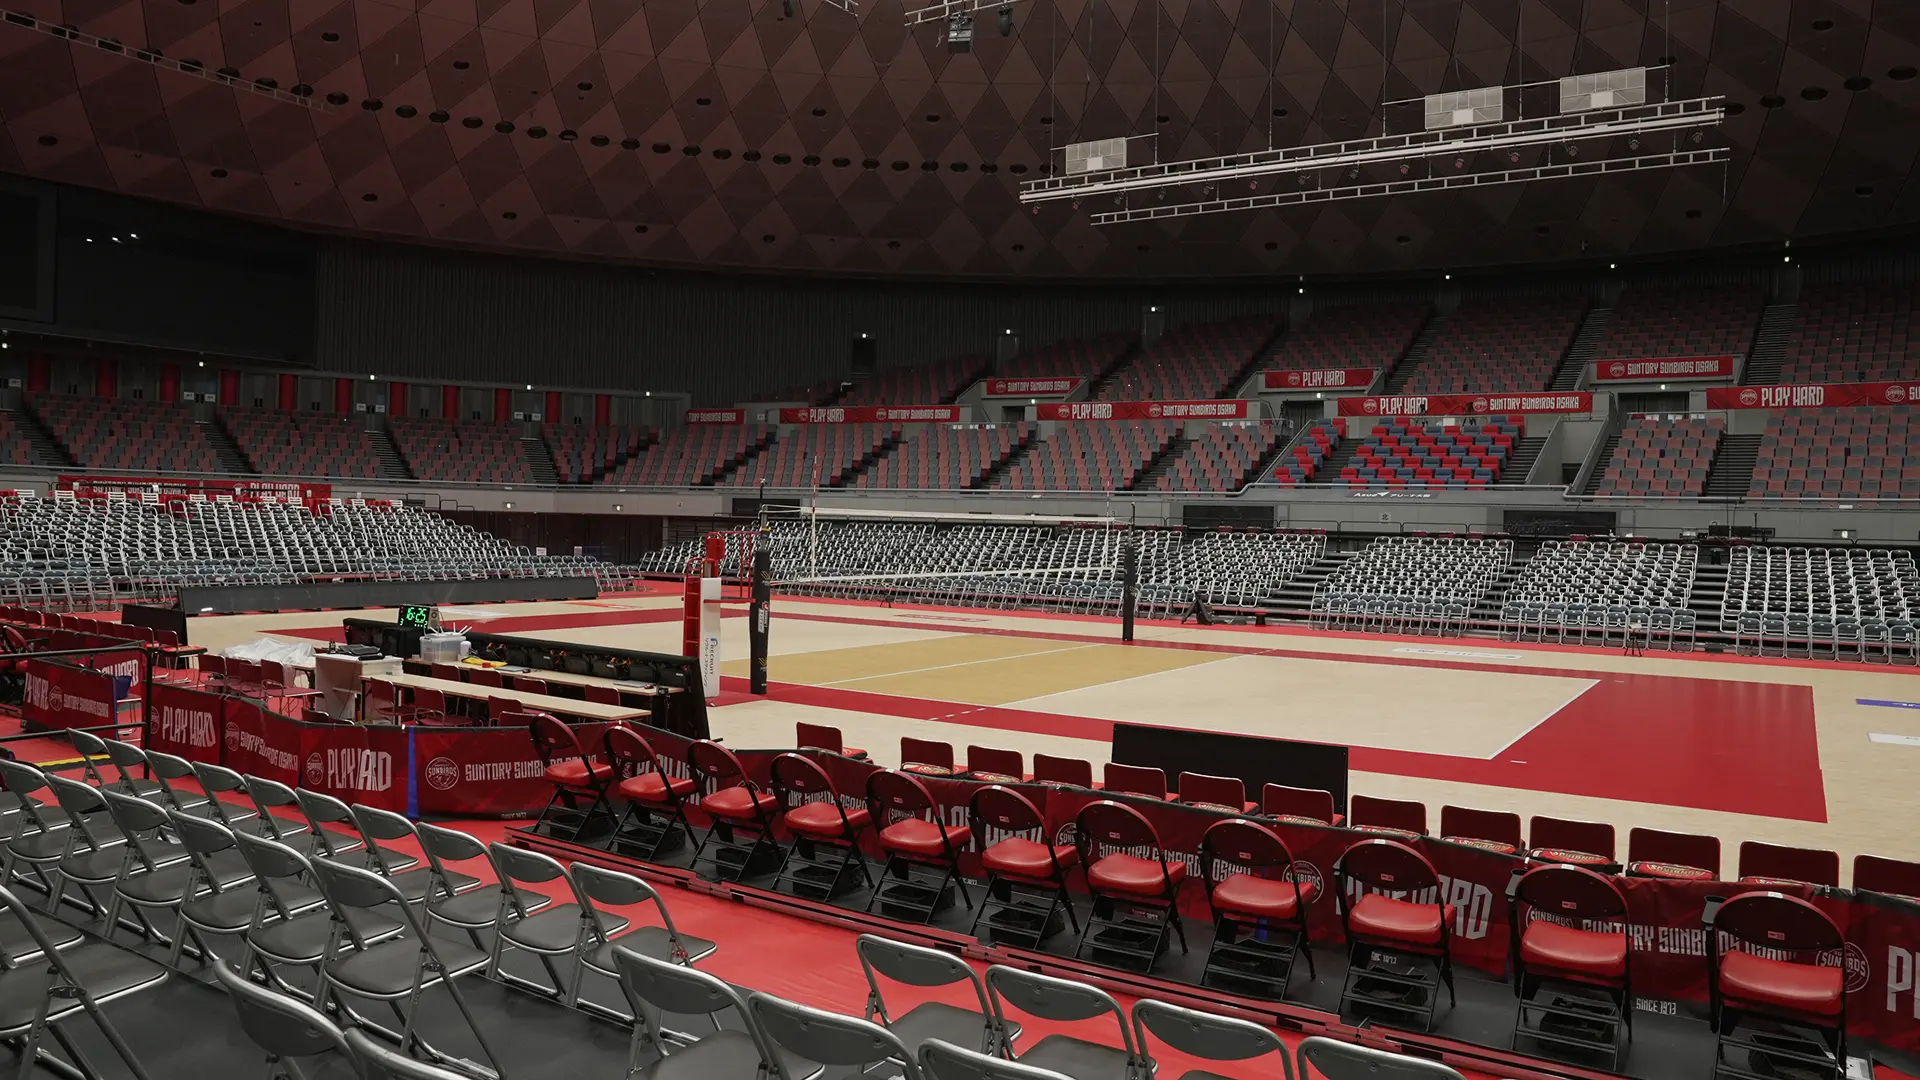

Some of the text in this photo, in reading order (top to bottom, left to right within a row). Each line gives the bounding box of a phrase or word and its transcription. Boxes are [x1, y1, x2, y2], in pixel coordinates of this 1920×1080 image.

[1627, 360, 1719, 376] SUNTORY SUNBIRDS OSAKA
[1302, 370, 1346, 387] PLAY HARD
[1490, 396, 1579, 411] SUNTORY SUNBIRDS OSAKA
[1761, 386, 1824, 407] PLAY HARD
[1072, 403, 1112, 419] PLAY HARD
[1162, 403, 1236, 416] SUNTORY SUNBIRDS OSAKA
[1380, 398, 1402, 415] PLAY
[809, 408, 845, 423] PLAY HARD
[162, 705, 216, 747] PLAY HARD
[327, 748, 356, 789] PLAY
[428, 766, 457, 778] SUNBIRDS
[465, 761, 512, 781] SUNTORY
[1285, 870, 1321, 891] SUBIRDS
[1820, 951, 1866, 977] SUNIRDS
[1635, 998, 1677, 1015] SINCE 1973
